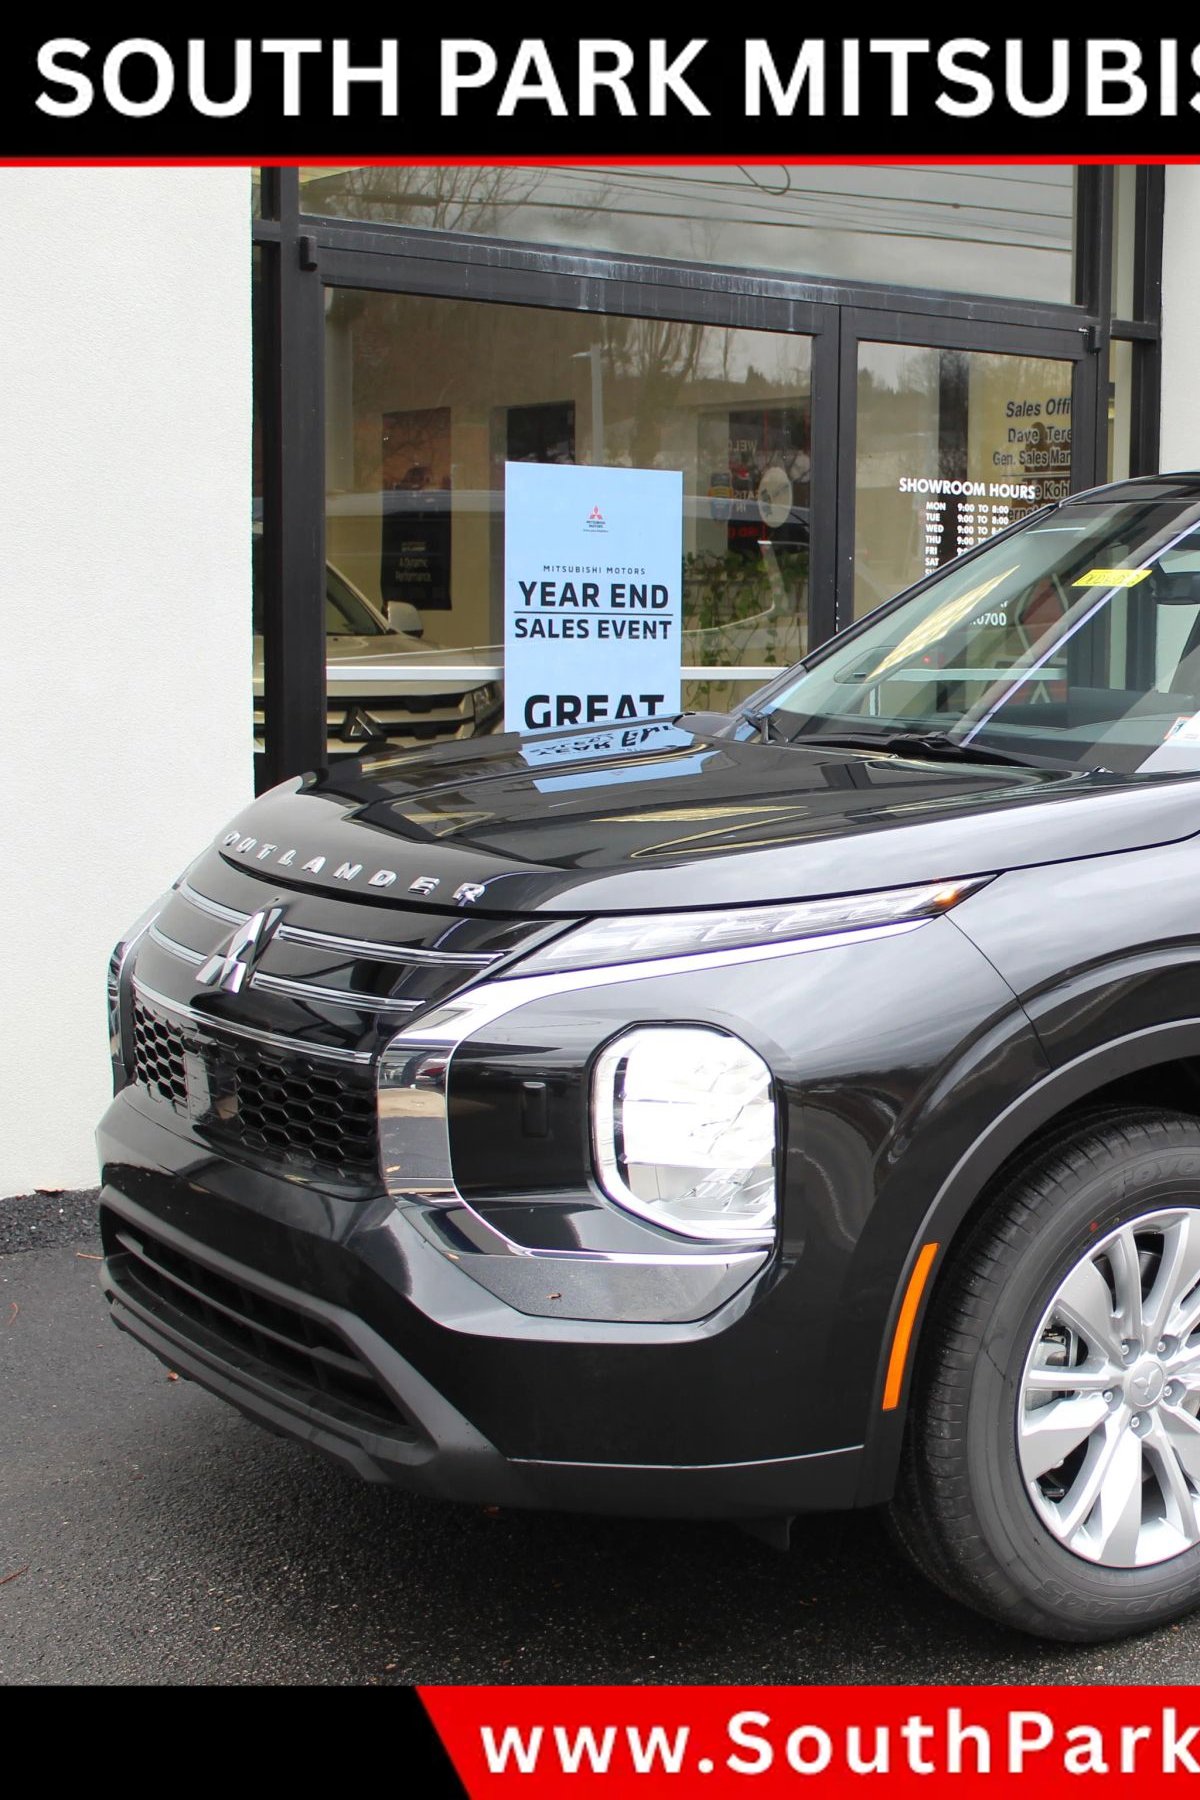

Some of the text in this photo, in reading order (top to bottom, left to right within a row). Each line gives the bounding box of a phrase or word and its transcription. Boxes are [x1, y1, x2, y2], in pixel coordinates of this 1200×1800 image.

[1006, 400, 1041, 418] Sales
[1008, 428, 1039, 443] Dave
[993, 451, 1016, 466] Gen.
[1019, 450, 1047, 466] Sales
[899, 478, 985, 496] SHOWROOM
[990, 484, 1035, 499] HOURS
[926, 502, 946, 511] MON
[957, 503, 975, 512] 9:00
[978, 504, 988, 513] TO
[992, 505, 1009, 514] 8:00
[926, 513, 1009, 526] TUE 9:00 TO 8:00
[926, 524, 944, 533] WED
[957, 526, 974, 535] 9:00
[977, 527, 988, 535] TO
[926, 535, 941, 544] THU
[957, 537, 974, 546] 9:00
[925, 546, 937, 555] FRI
[925, 558, 939, 566] SAT
[543, 565, 645, 575] MITSUBISHI MOTORS
[518, 581, 669, 609] YEAR END
[515, 618, 672, 639] SALES EVENT
[524, 694, 664, 731] GREAT
[222, 832, 486, 903] OUTLANDER
